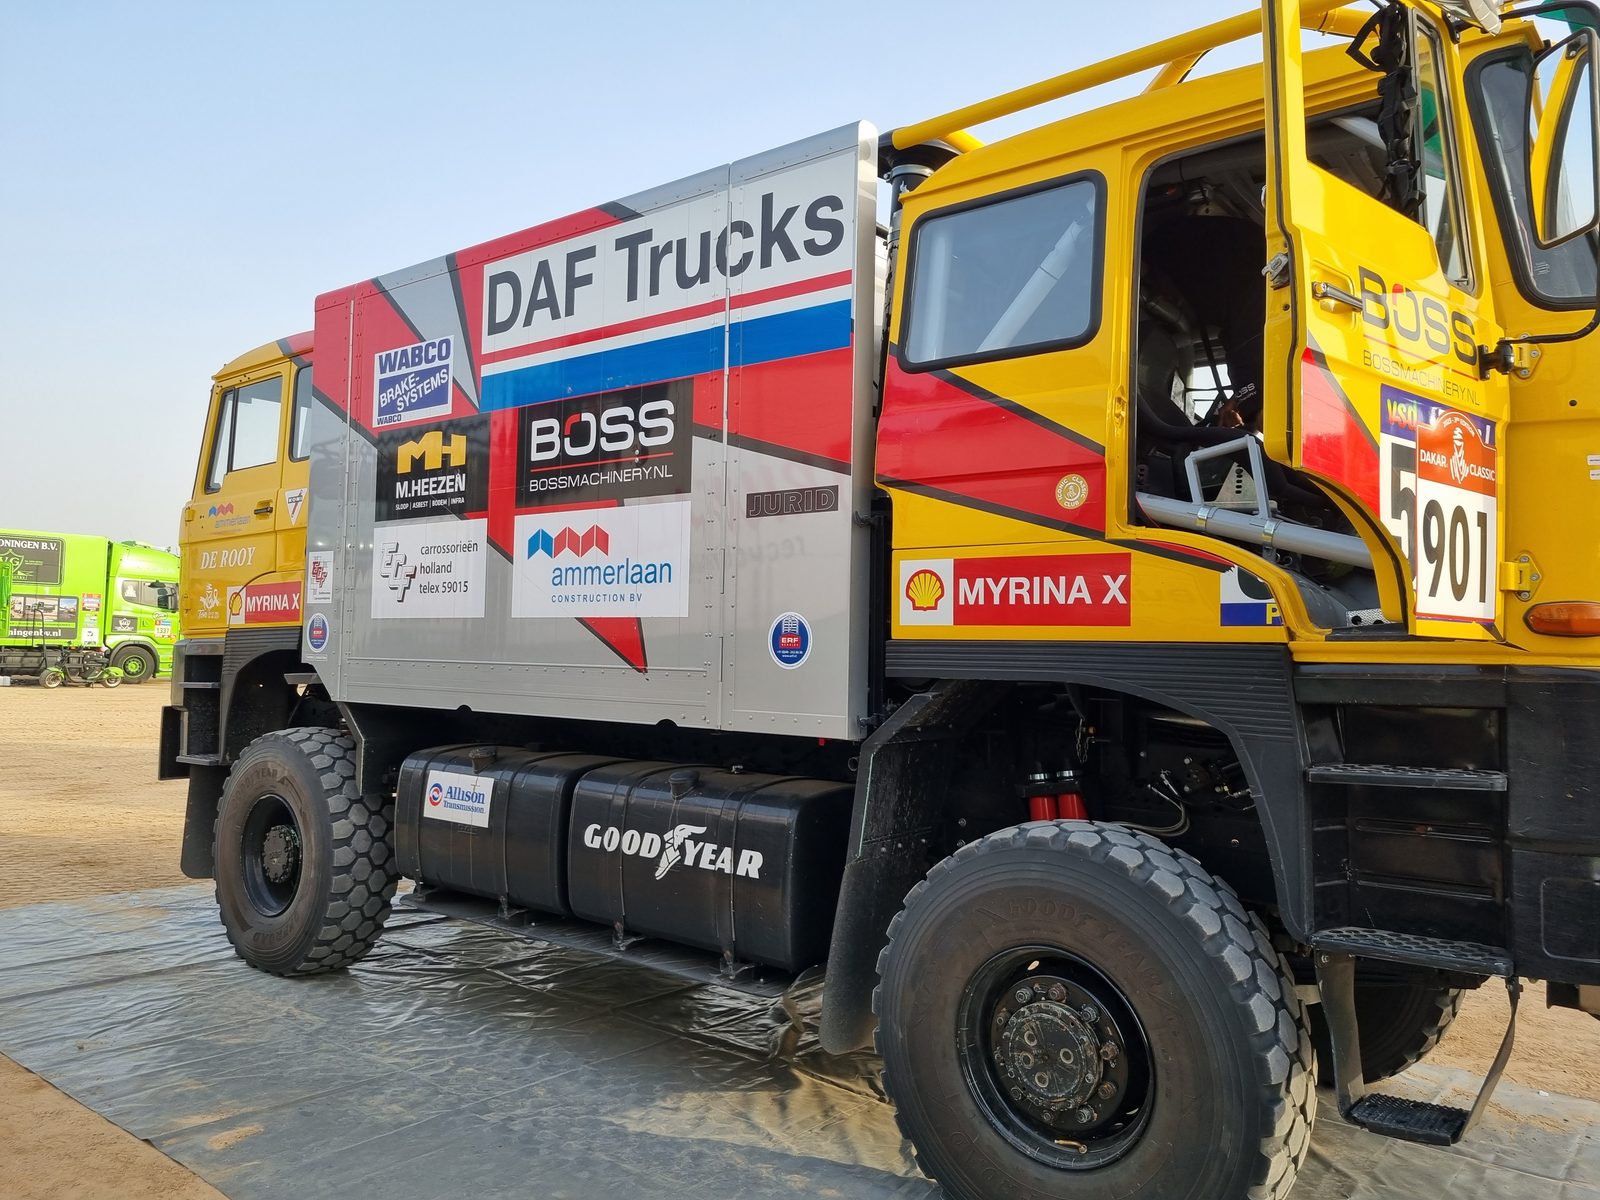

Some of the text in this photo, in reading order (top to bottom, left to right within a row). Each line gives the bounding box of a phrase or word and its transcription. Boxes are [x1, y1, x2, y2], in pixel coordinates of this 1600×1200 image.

[488, 192, 845, 336] DAF Trucks
[1359, 265, 1478, 366] BOSS
[379, 338, 451, 374] WABCO
[380, 373, 420, 408] BRAKE-
[396, 368, 449, 412] SYSTEMS
[377, 414, 402, 425] WABCO
[531, 400, 675, 461] BOSS
[397, 431, 467, 474] MH
[1420, 449, 1496, 482] DAKAR CLASSIC
[395, 473, 466, 499] M.HEEZEN
[450, 497, 465, 505] INFRA
[749, 488, 836, 517] JURID
[41, 541, 58, 551] B.V.
[200, 546, 256, 570] DE ROOY
[1423, 500, 1488, 603] 901
[419, 560, 453, 574] holland
[551, 557, 672, 587] ammerlaan
[419, 580, 469, 594] telex 59015
[551, 593, 643, 603] CONSTRUCTION BV
[959, 574, 1128, 606] MYRINA X
[245, 592, 300, 613] MYRINA X
[444, 785, 486, 805] Allison
